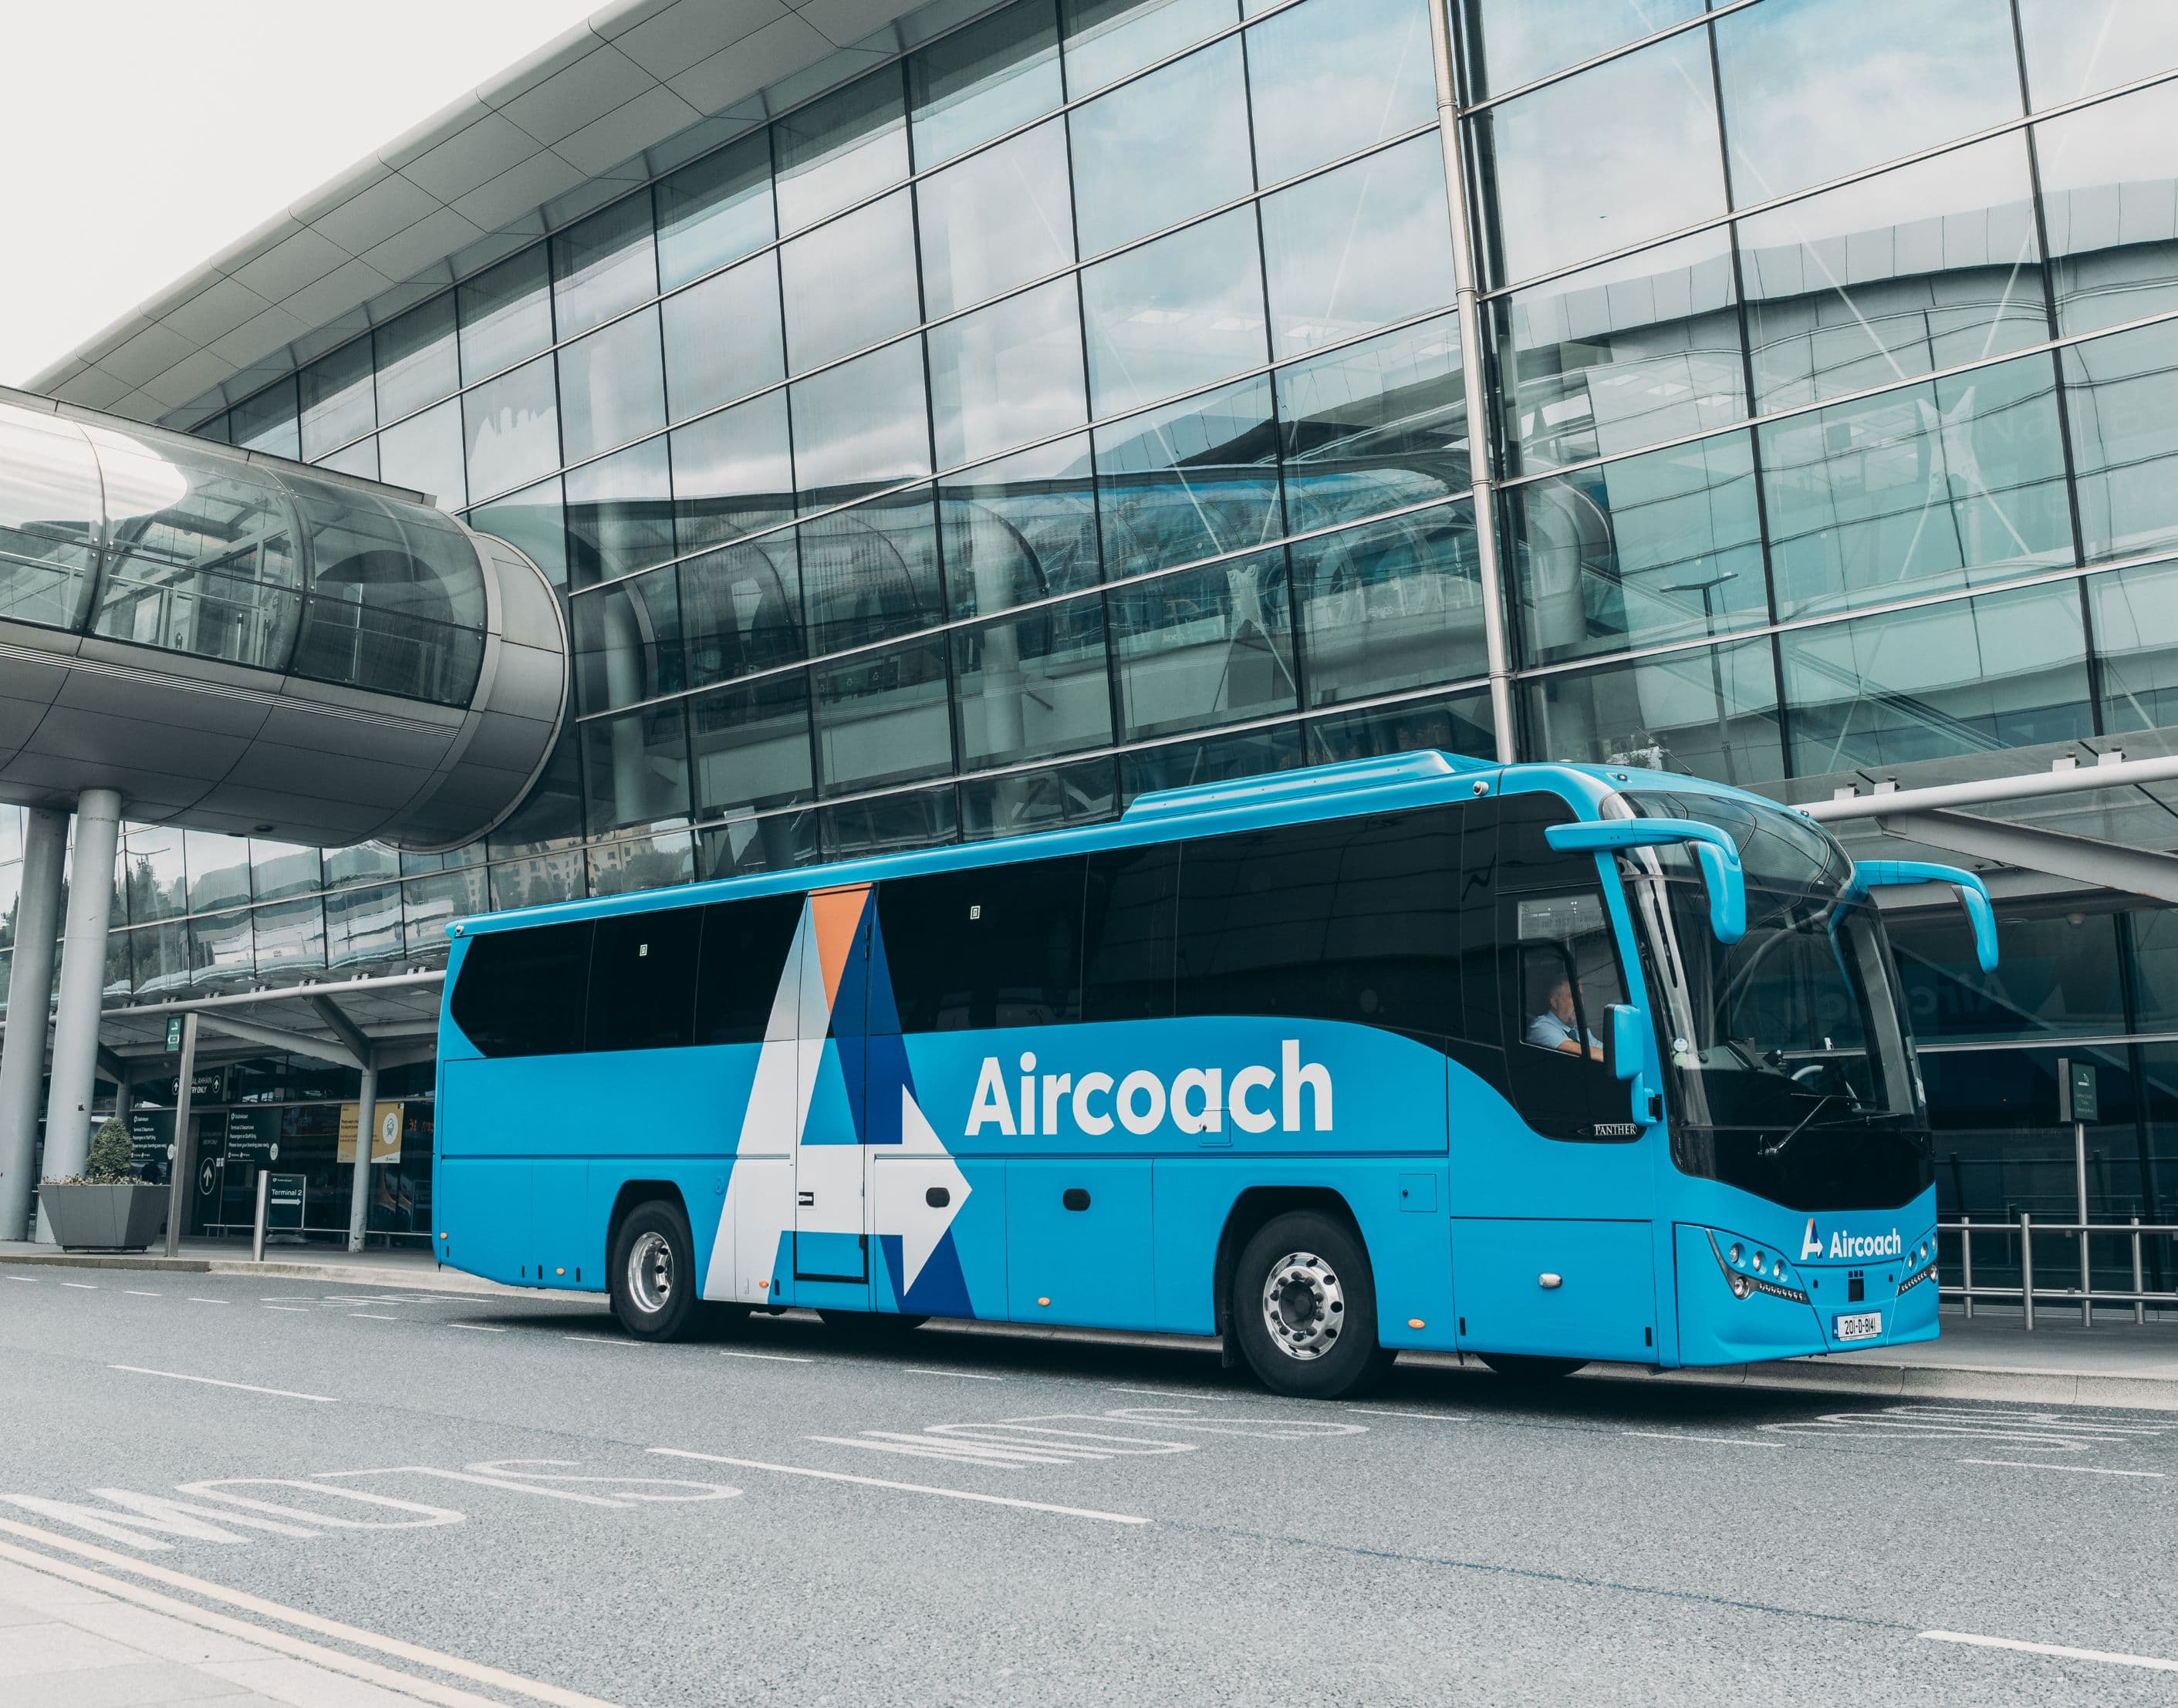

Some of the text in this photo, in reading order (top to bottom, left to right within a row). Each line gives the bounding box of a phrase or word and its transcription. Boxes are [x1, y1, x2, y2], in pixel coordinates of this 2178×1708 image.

[964, 1039, 1333, 1136] Aircoach
[1595, 1124, 1636, 1136] PANTHER
[271, 1188, 297, 1197] Terminal
[1829, 1227, 1902, 1259] Aircoach
[1844, 1318, 1876, 1335] 201-D-8141
